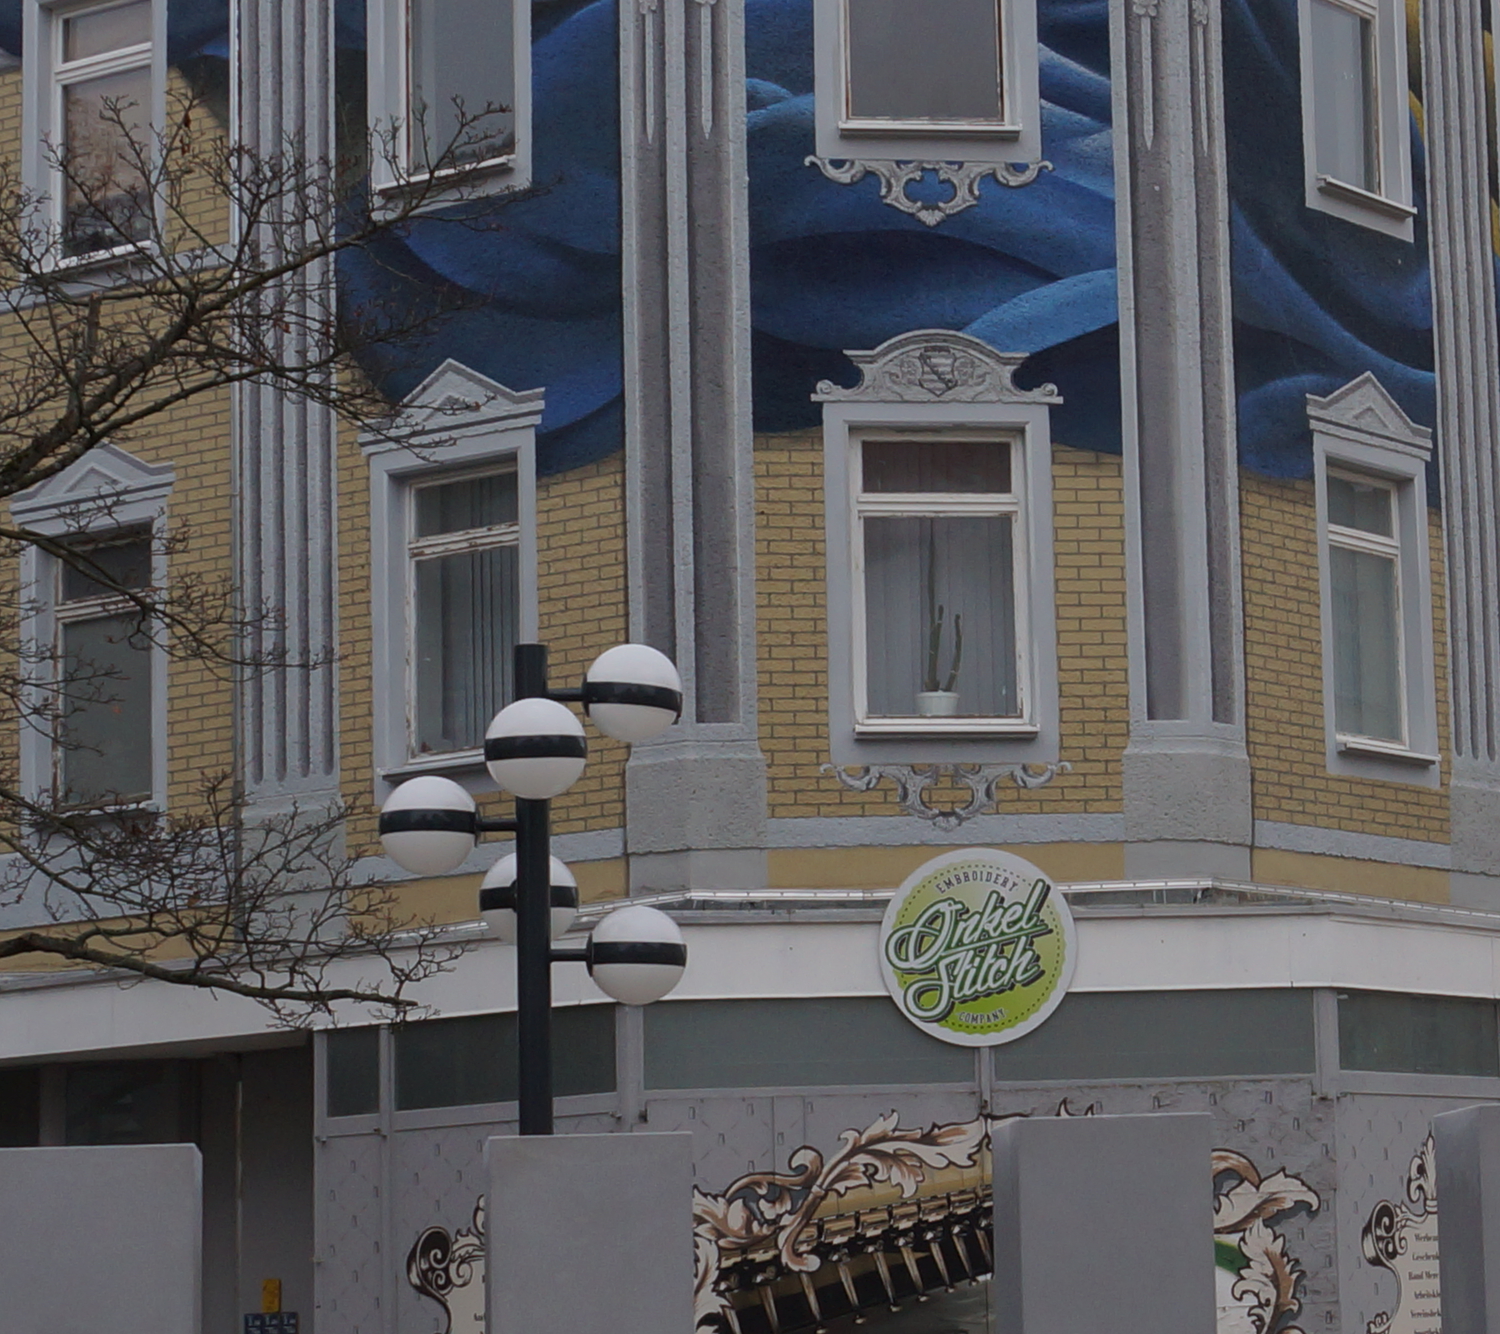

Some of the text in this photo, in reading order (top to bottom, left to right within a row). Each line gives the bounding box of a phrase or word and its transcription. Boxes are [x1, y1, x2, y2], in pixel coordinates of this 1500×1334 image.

[936, 870, 1019, 895] EMBROIDERY
[885, 878, 1051, 973] Onkel
[904, 935, 1045, 1022] Stitch
[958, 1008, 1005, 1024] COMPANY
